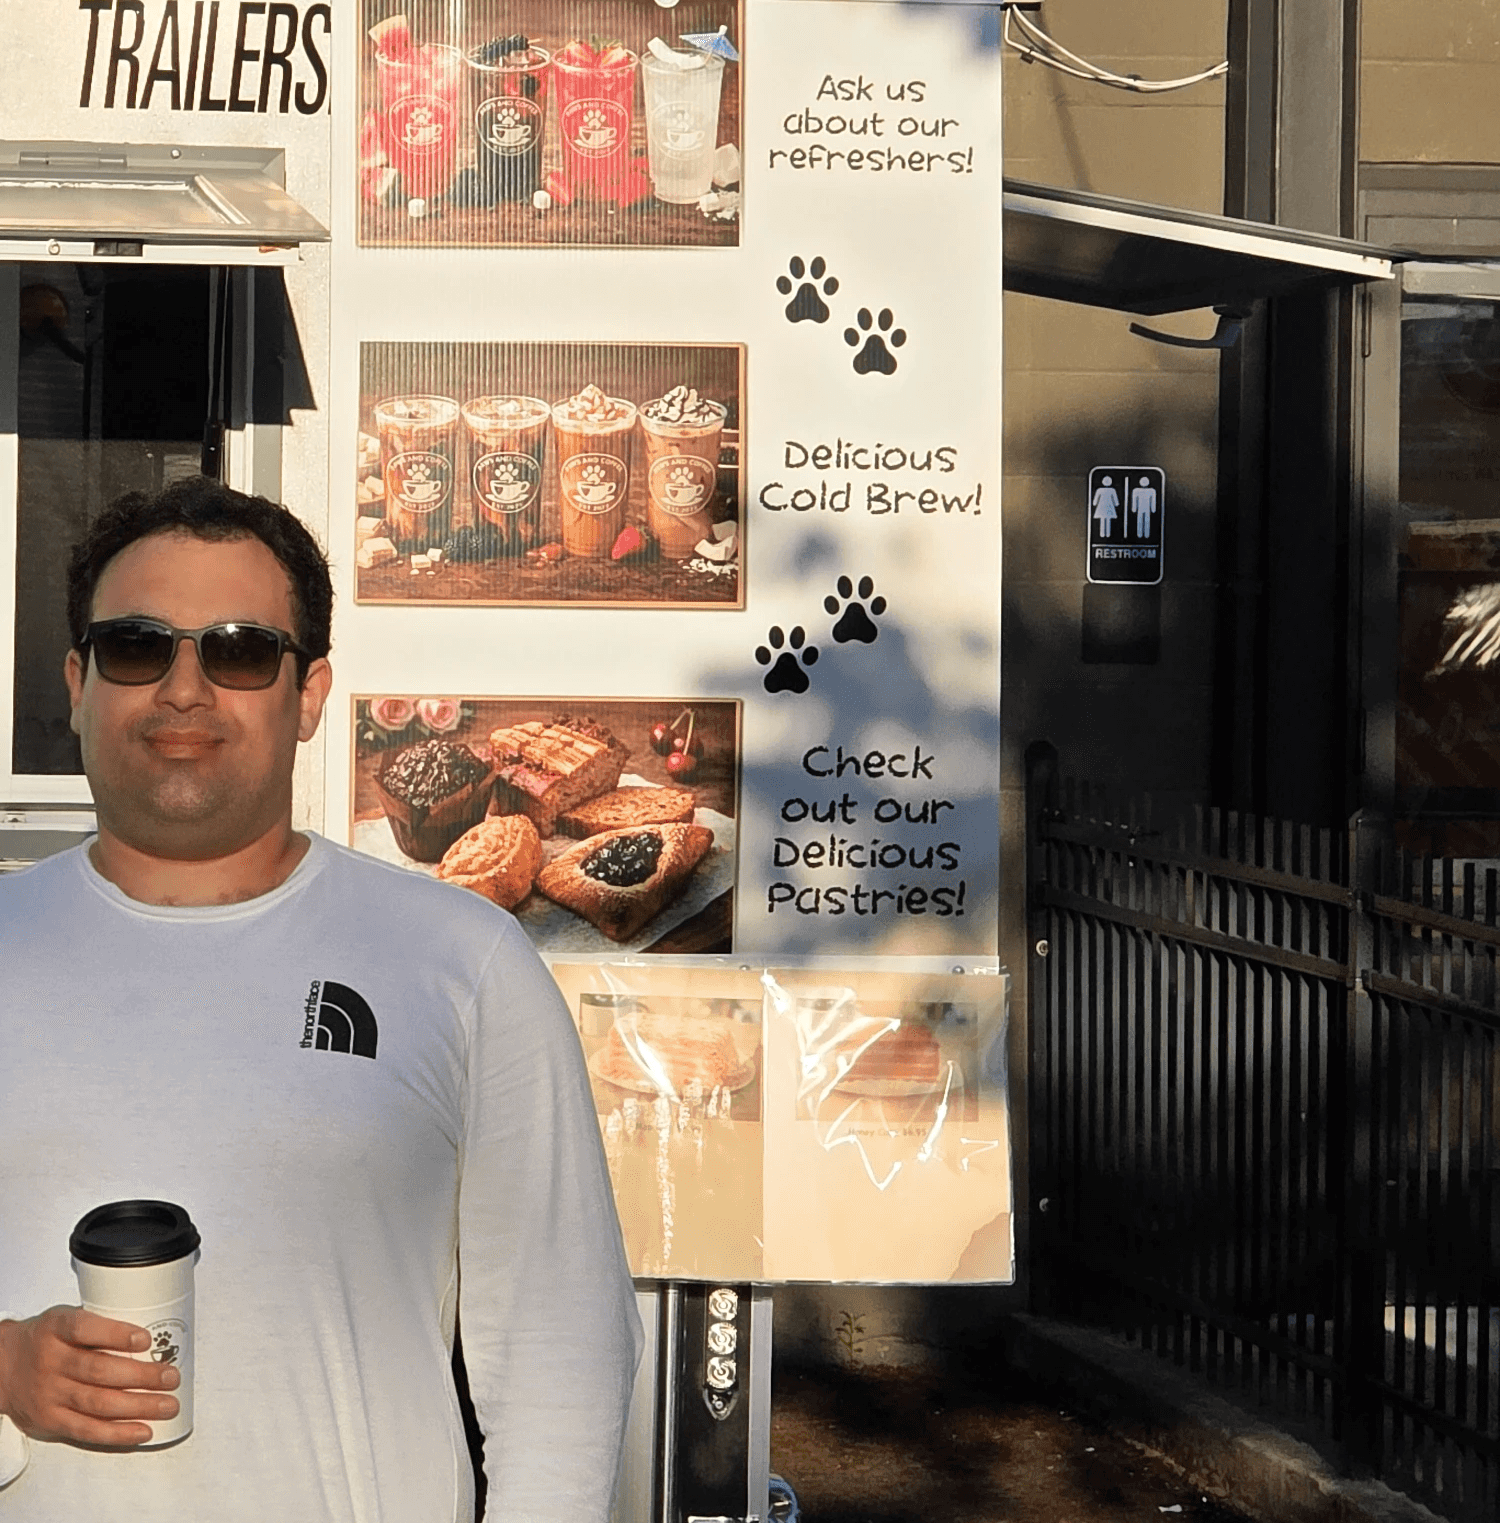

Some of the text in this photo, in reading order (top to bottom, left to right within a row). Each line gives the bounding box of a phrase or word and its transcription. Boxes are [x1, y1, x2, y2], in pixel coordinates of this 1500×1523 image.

[816, 75, 926, 103] Ask us
[783, 107, 959, 137] about our
[769, 144, 973, 174] refreshers!
[785, 437, 957, 473] Delicious
[759, 480, 982, 516] Cold Brew!
[1095, 548, 1157, 559] RESTROOM
[802, 745, 935, 780] Check
[781, 793, 955, 825] out our
[773, 832, 961, 871] Delicious
[767, 880, 966, 917] Pastries!
